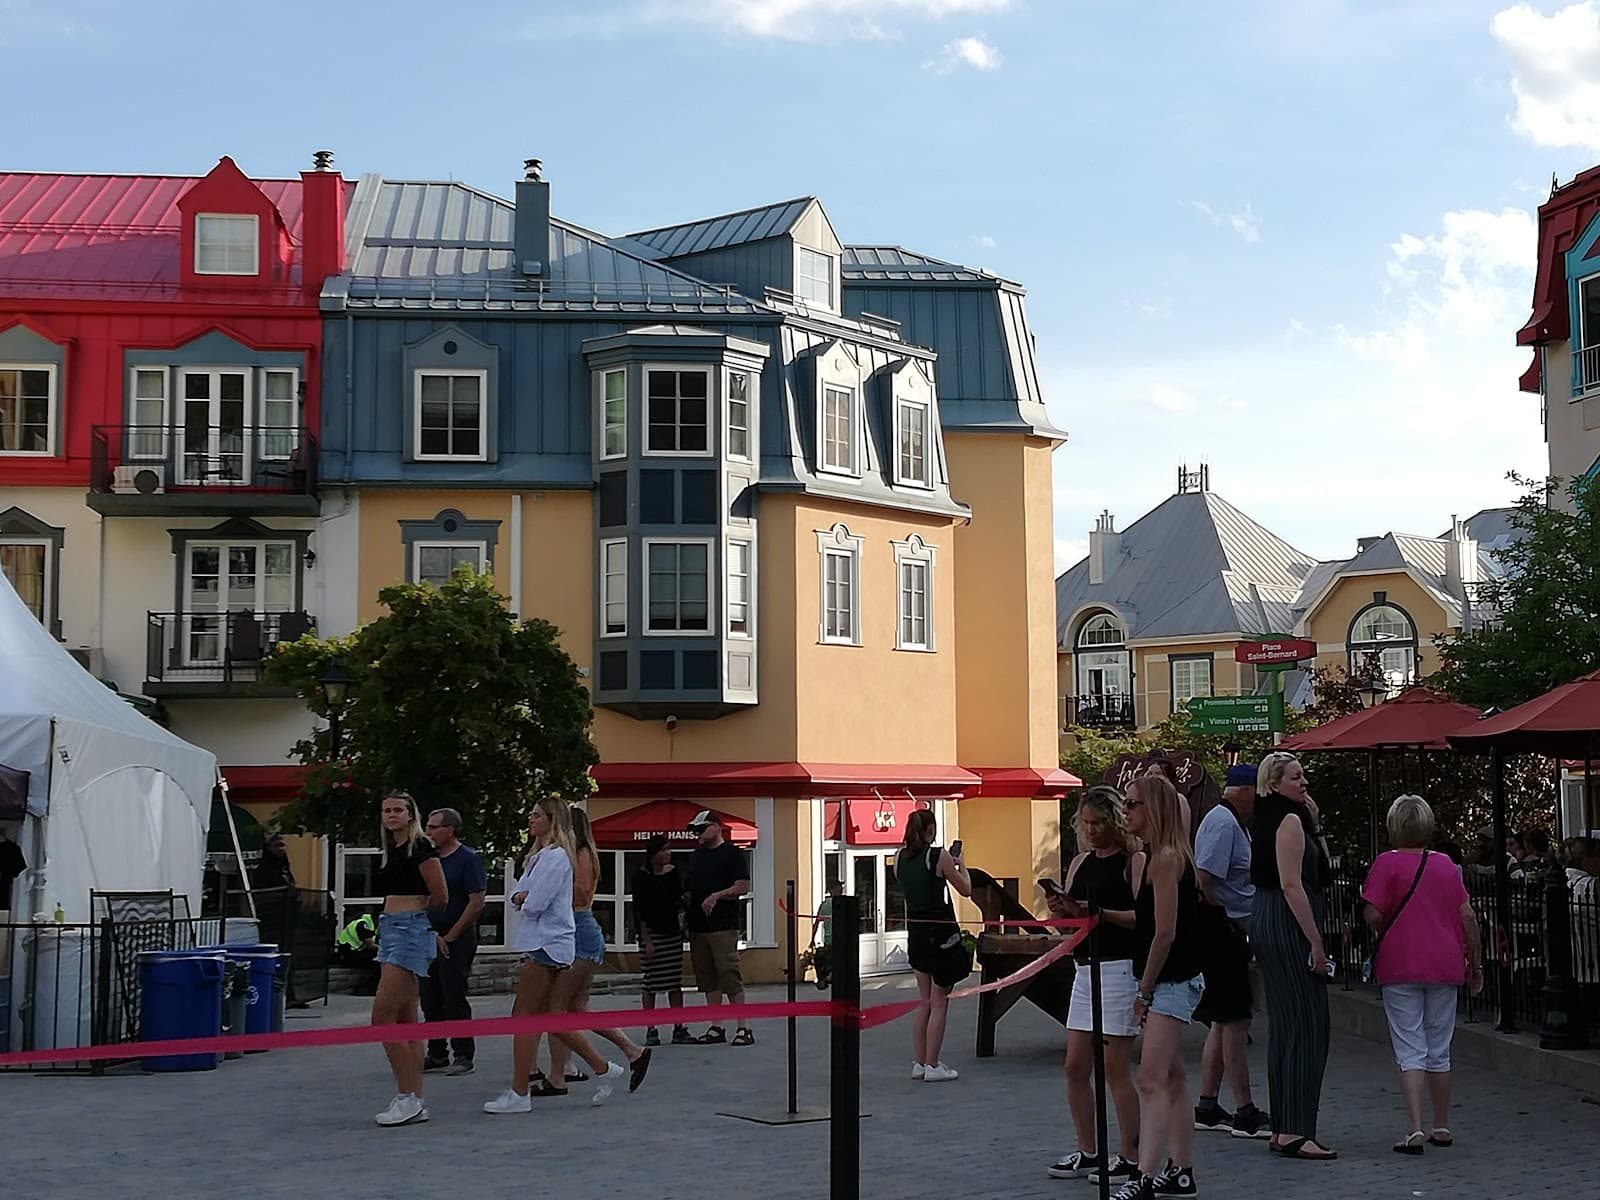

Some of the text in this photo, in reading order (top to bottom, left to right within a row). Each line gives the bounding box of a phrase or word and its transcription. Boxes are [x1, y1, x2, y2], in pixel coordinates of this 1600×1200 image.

[1262, 643, 1281, 651] Place
[1247, 649, 1297, 660] Saint-Bernard
[1208, 716, 1269, 725] Vieux-Tremblant
[668, 831, 700, 840] HANS
